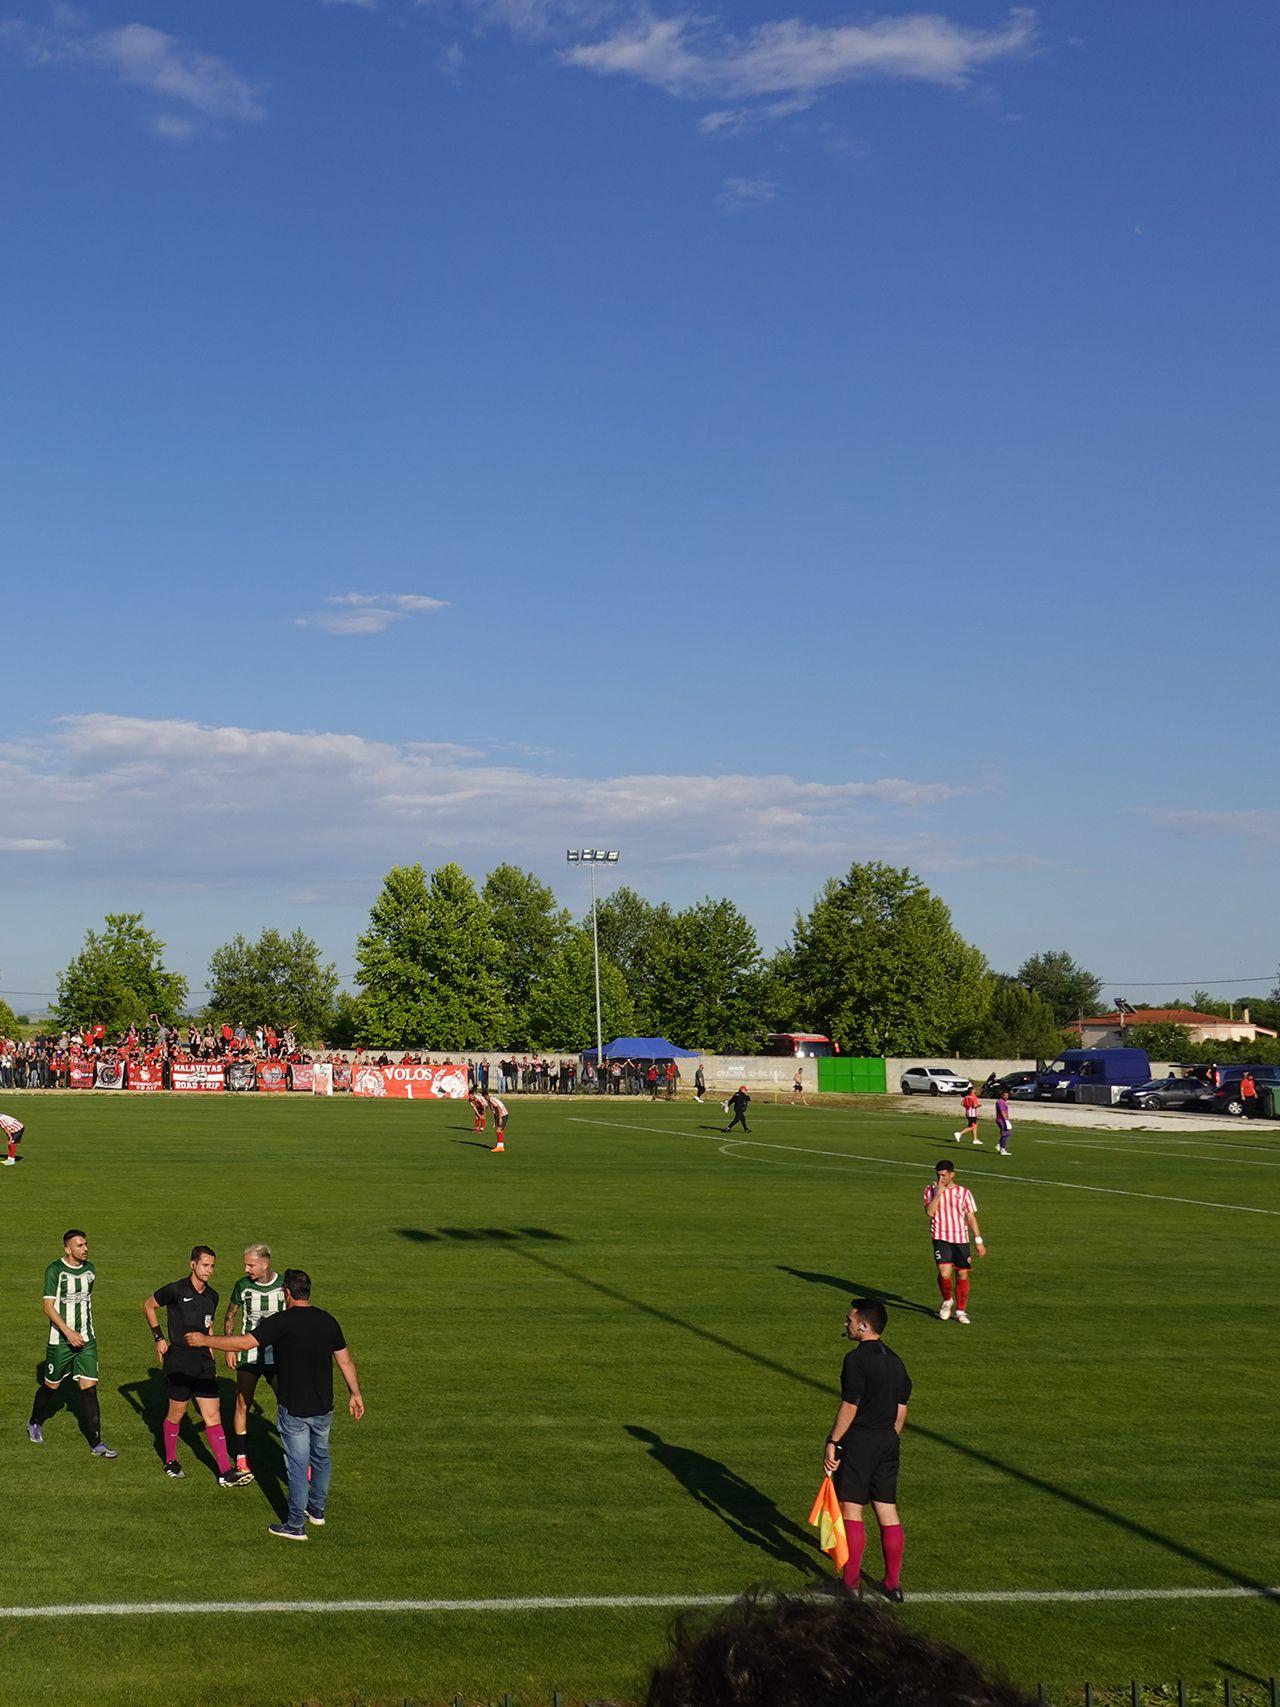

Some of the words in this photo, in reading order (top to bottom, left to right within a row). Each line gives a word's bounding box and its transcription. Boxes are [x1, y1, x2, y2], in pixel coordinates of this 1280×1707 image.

[173, 1064, 222, 1072] MALAVETAS
[384, 1067, 433, 1081] VOLOS
[404, 1083, 414, 1099] 1
[48, 1363, 54, 1375] 9
